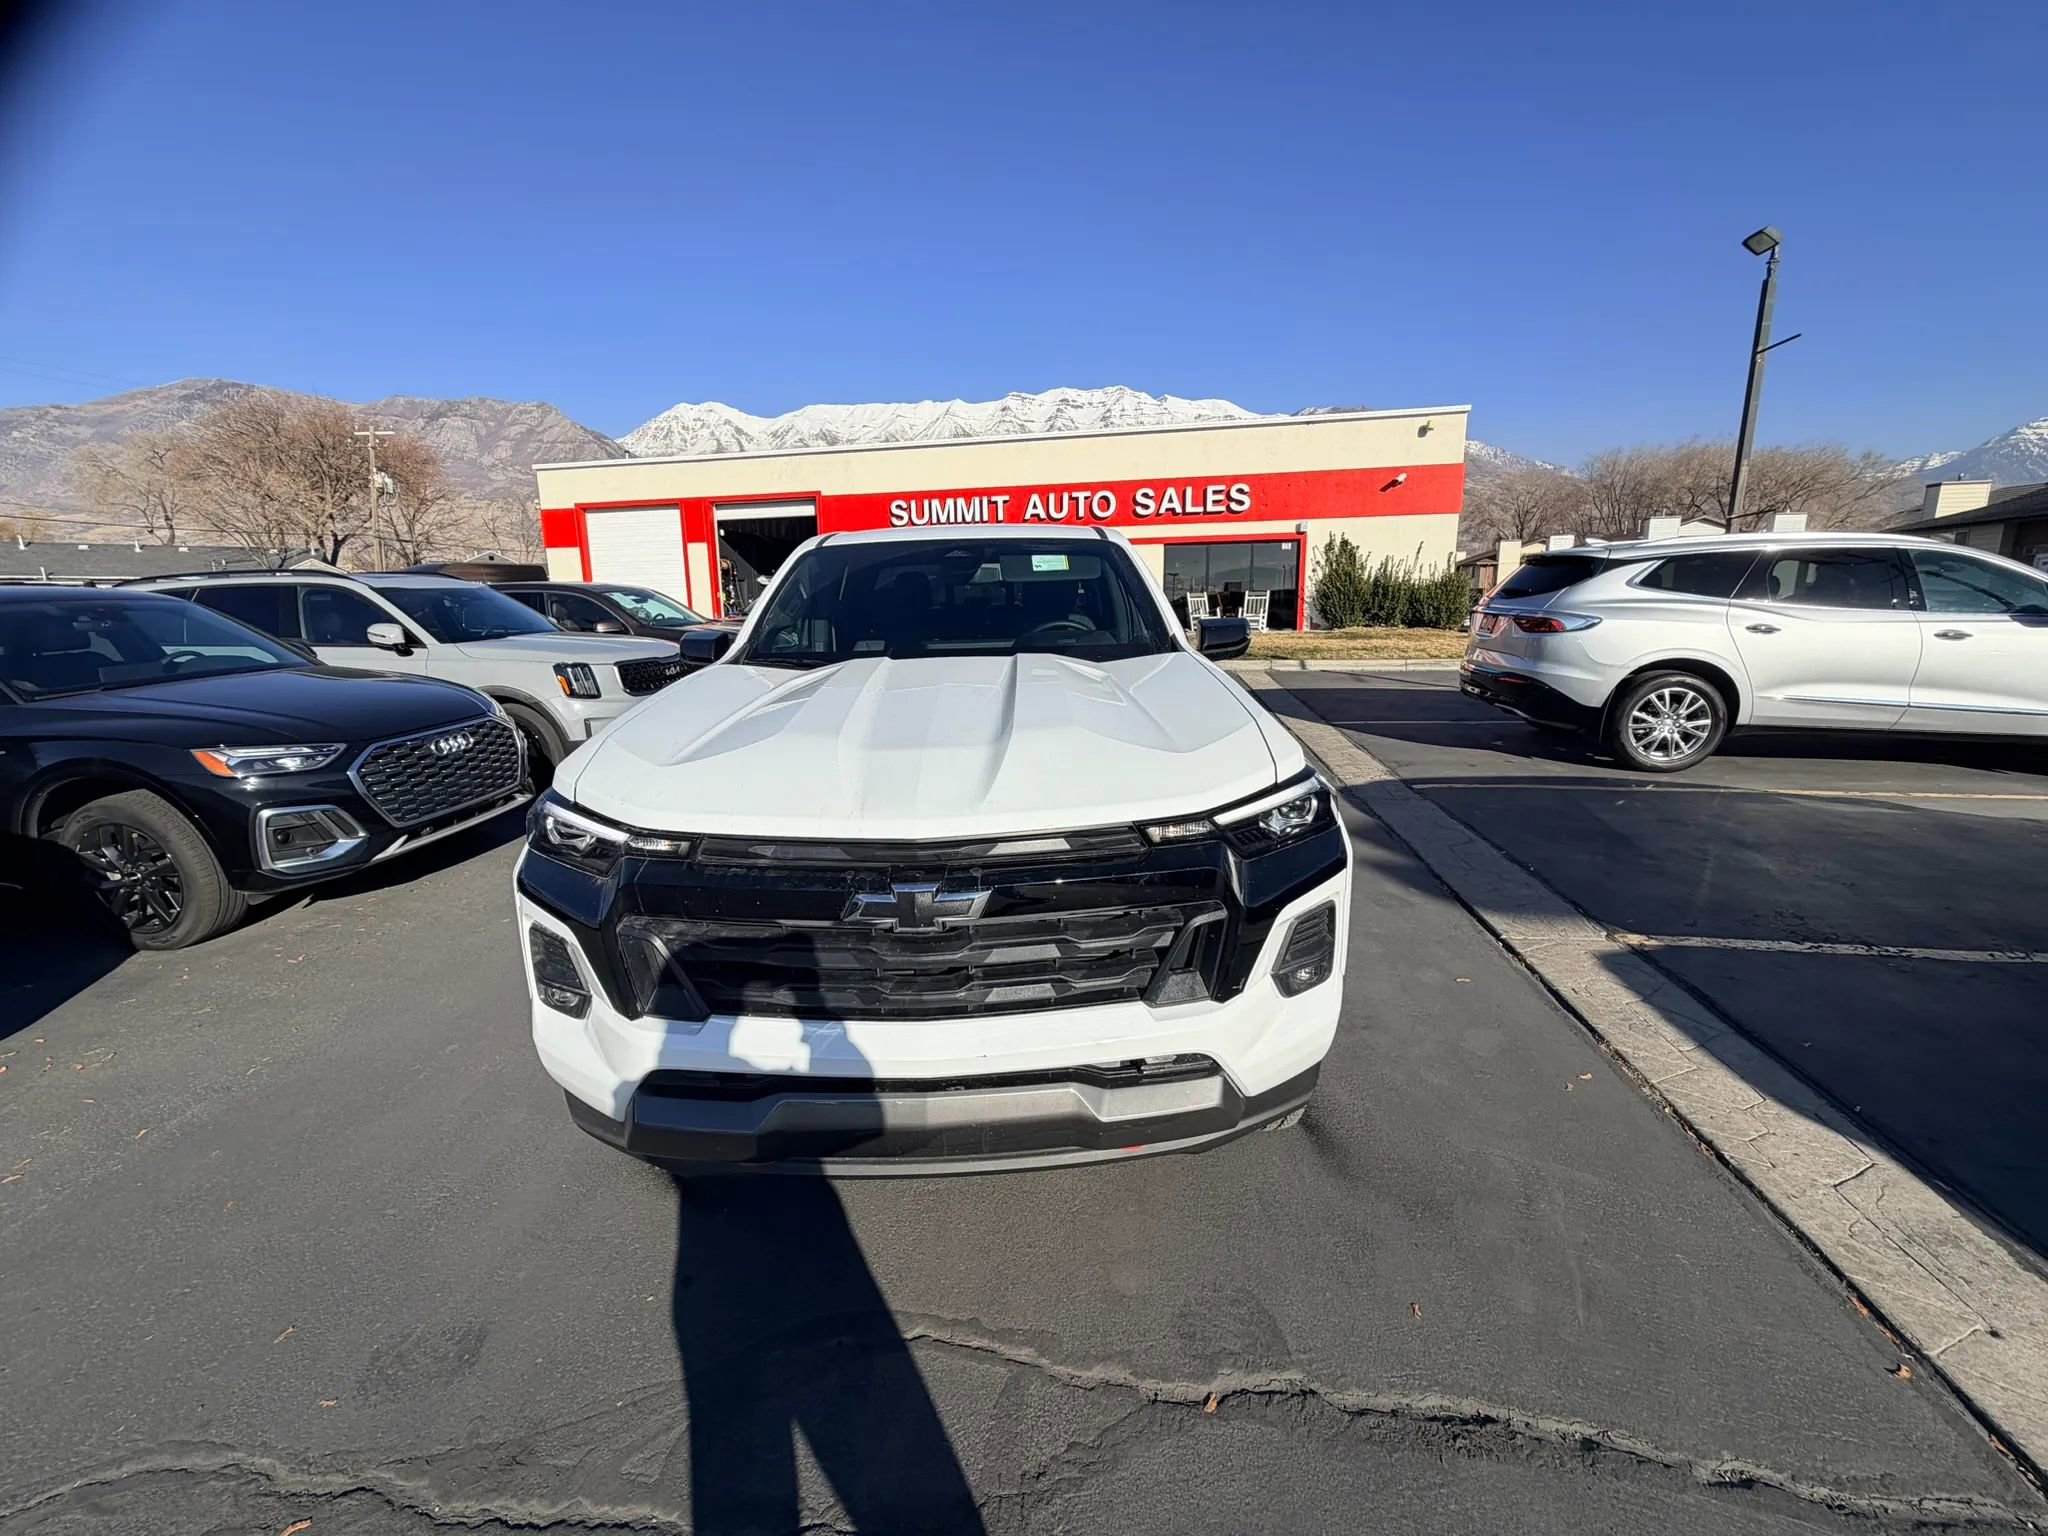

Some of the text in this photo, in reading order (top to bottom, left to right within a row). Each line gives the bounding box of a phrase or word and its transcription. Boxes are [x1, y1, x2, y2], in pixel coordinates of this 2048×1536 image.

[890, 483, 1251, 526] SUMMIT AUTO SALES
